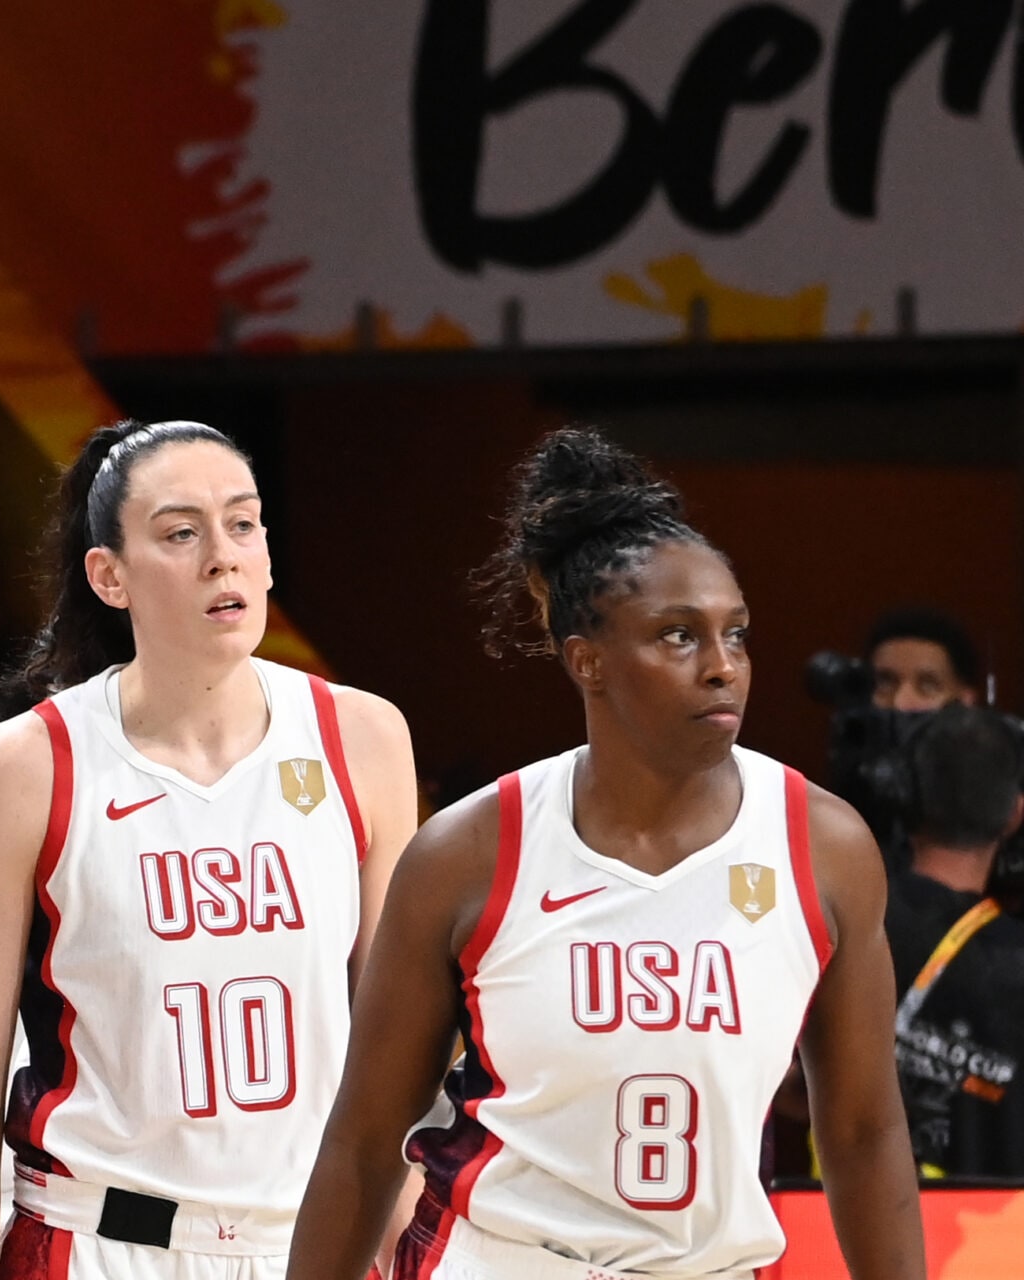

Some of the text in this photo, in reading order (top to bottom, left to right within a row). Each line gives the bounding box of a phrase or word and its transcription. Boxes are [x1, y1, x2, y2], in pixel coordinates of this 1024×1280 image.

[410, 0, 1024, 276] Ber
[140, 842, 305, 941] USA
[164, 976, 296, 1118] 10
[570, 941, 742, 1034] USA
[614, 1074, 698, 1211] 8
